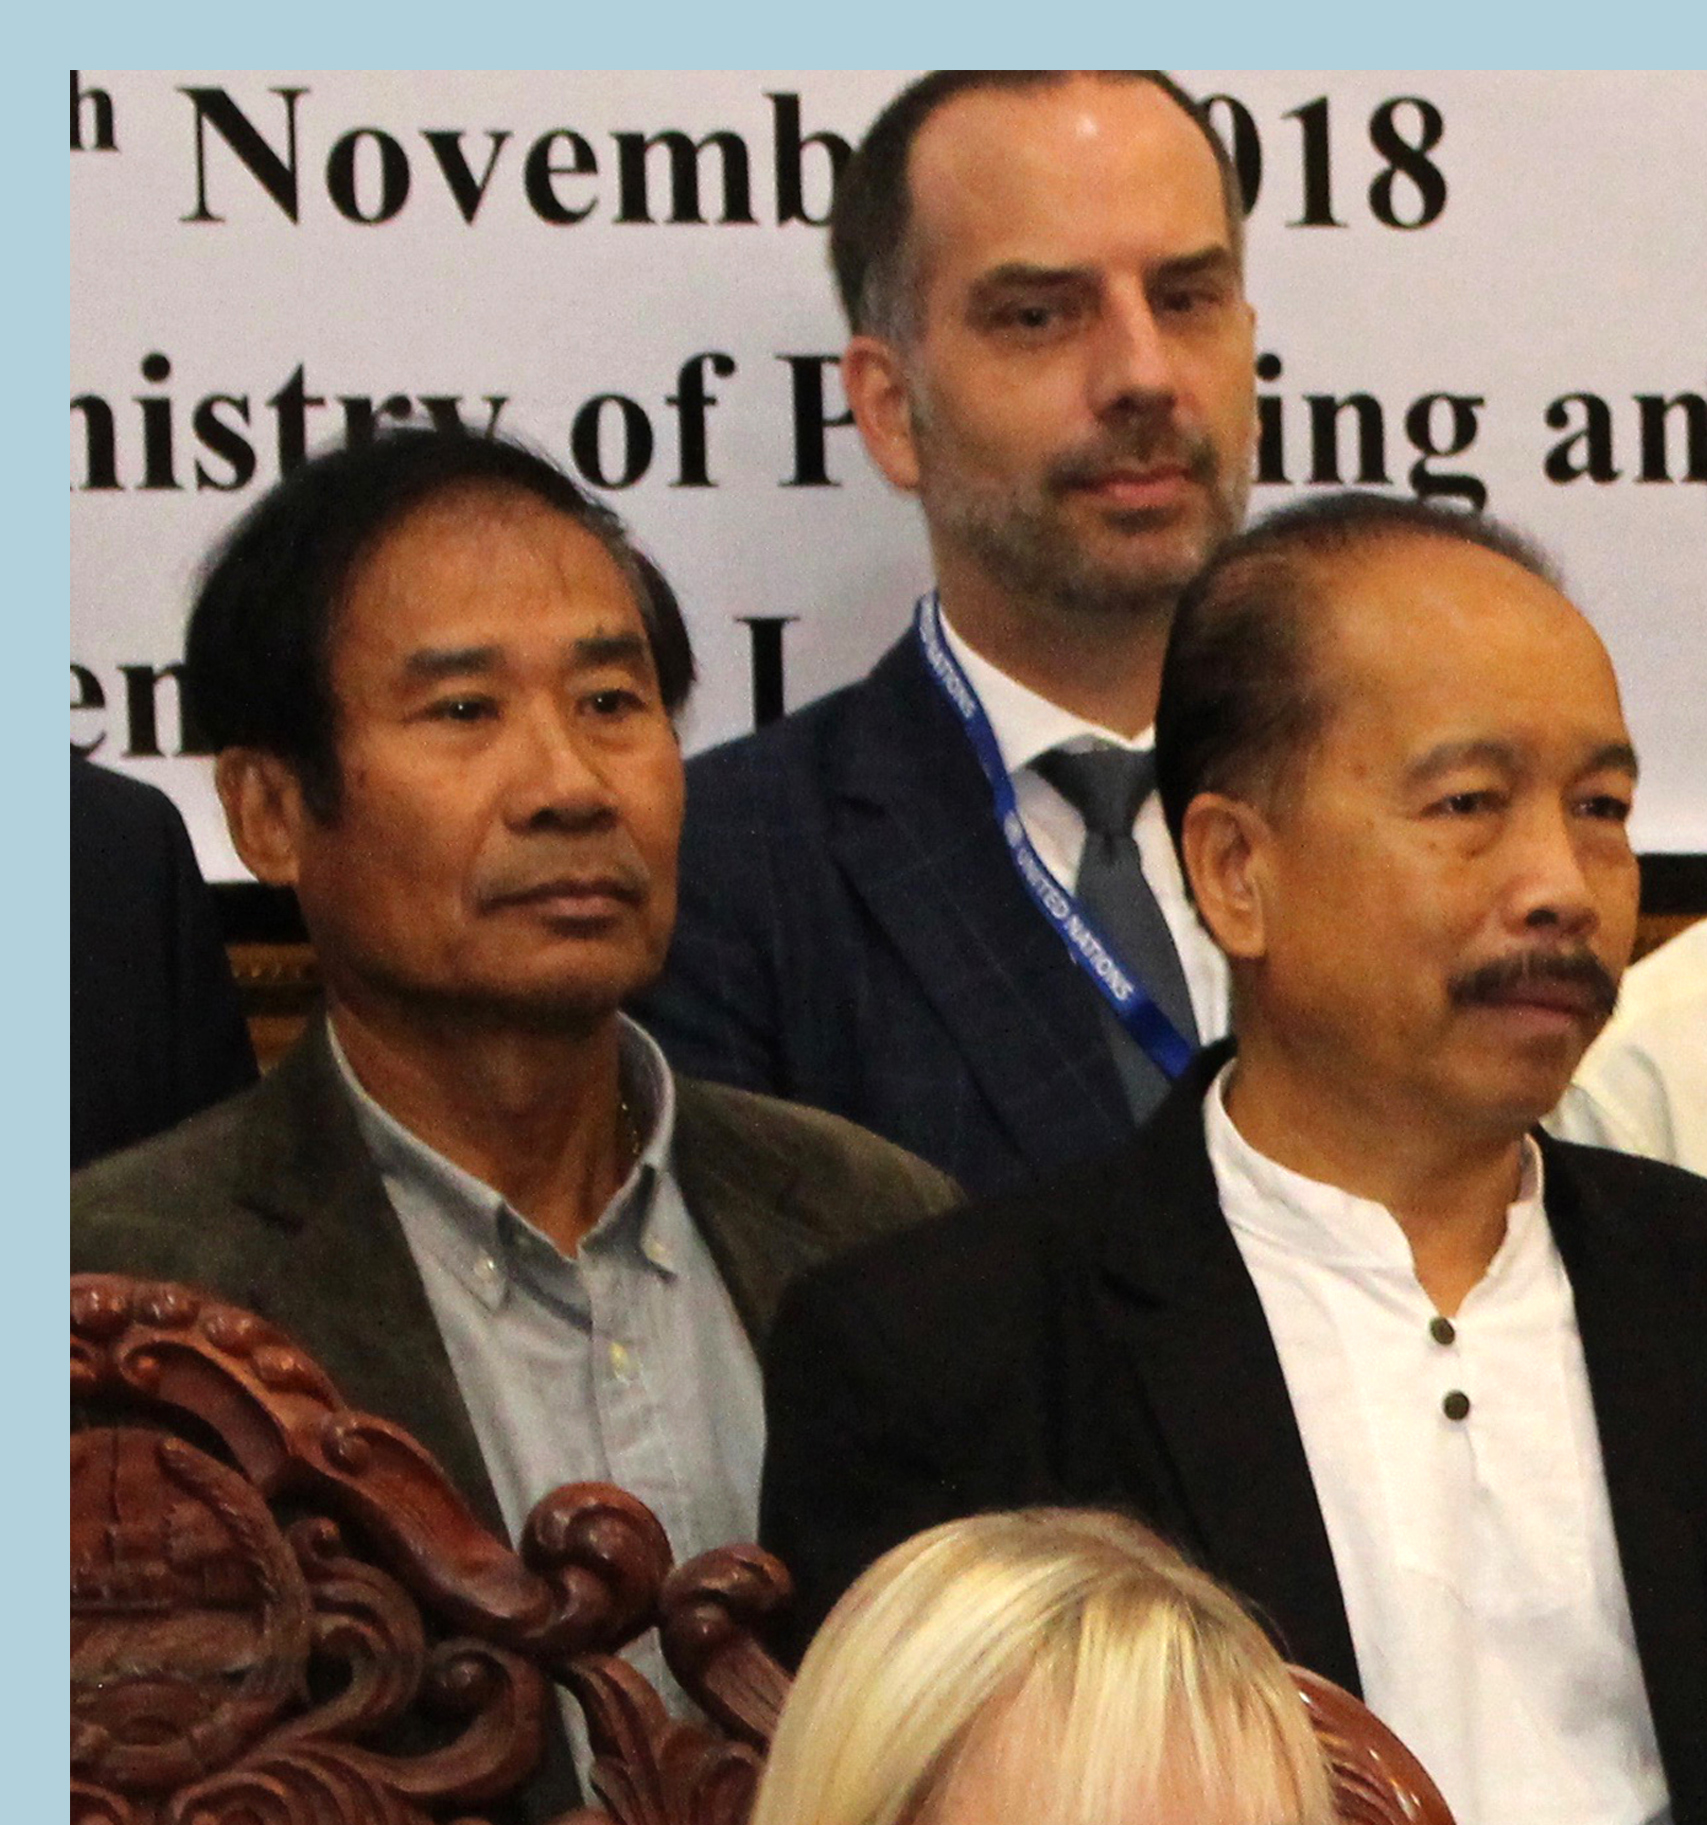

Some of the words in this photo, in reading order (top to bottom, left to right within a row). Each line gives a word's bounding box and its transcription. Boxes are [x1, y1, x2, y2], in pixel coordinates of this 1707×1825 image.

[70, 71, 119, 152] h
[176, 86, 855, 227] Novemb
[1198, 94, 1448, 230] 018
[570, 352, 735, 491] of
[1065, 914, 1134, 1000] NATIONS
